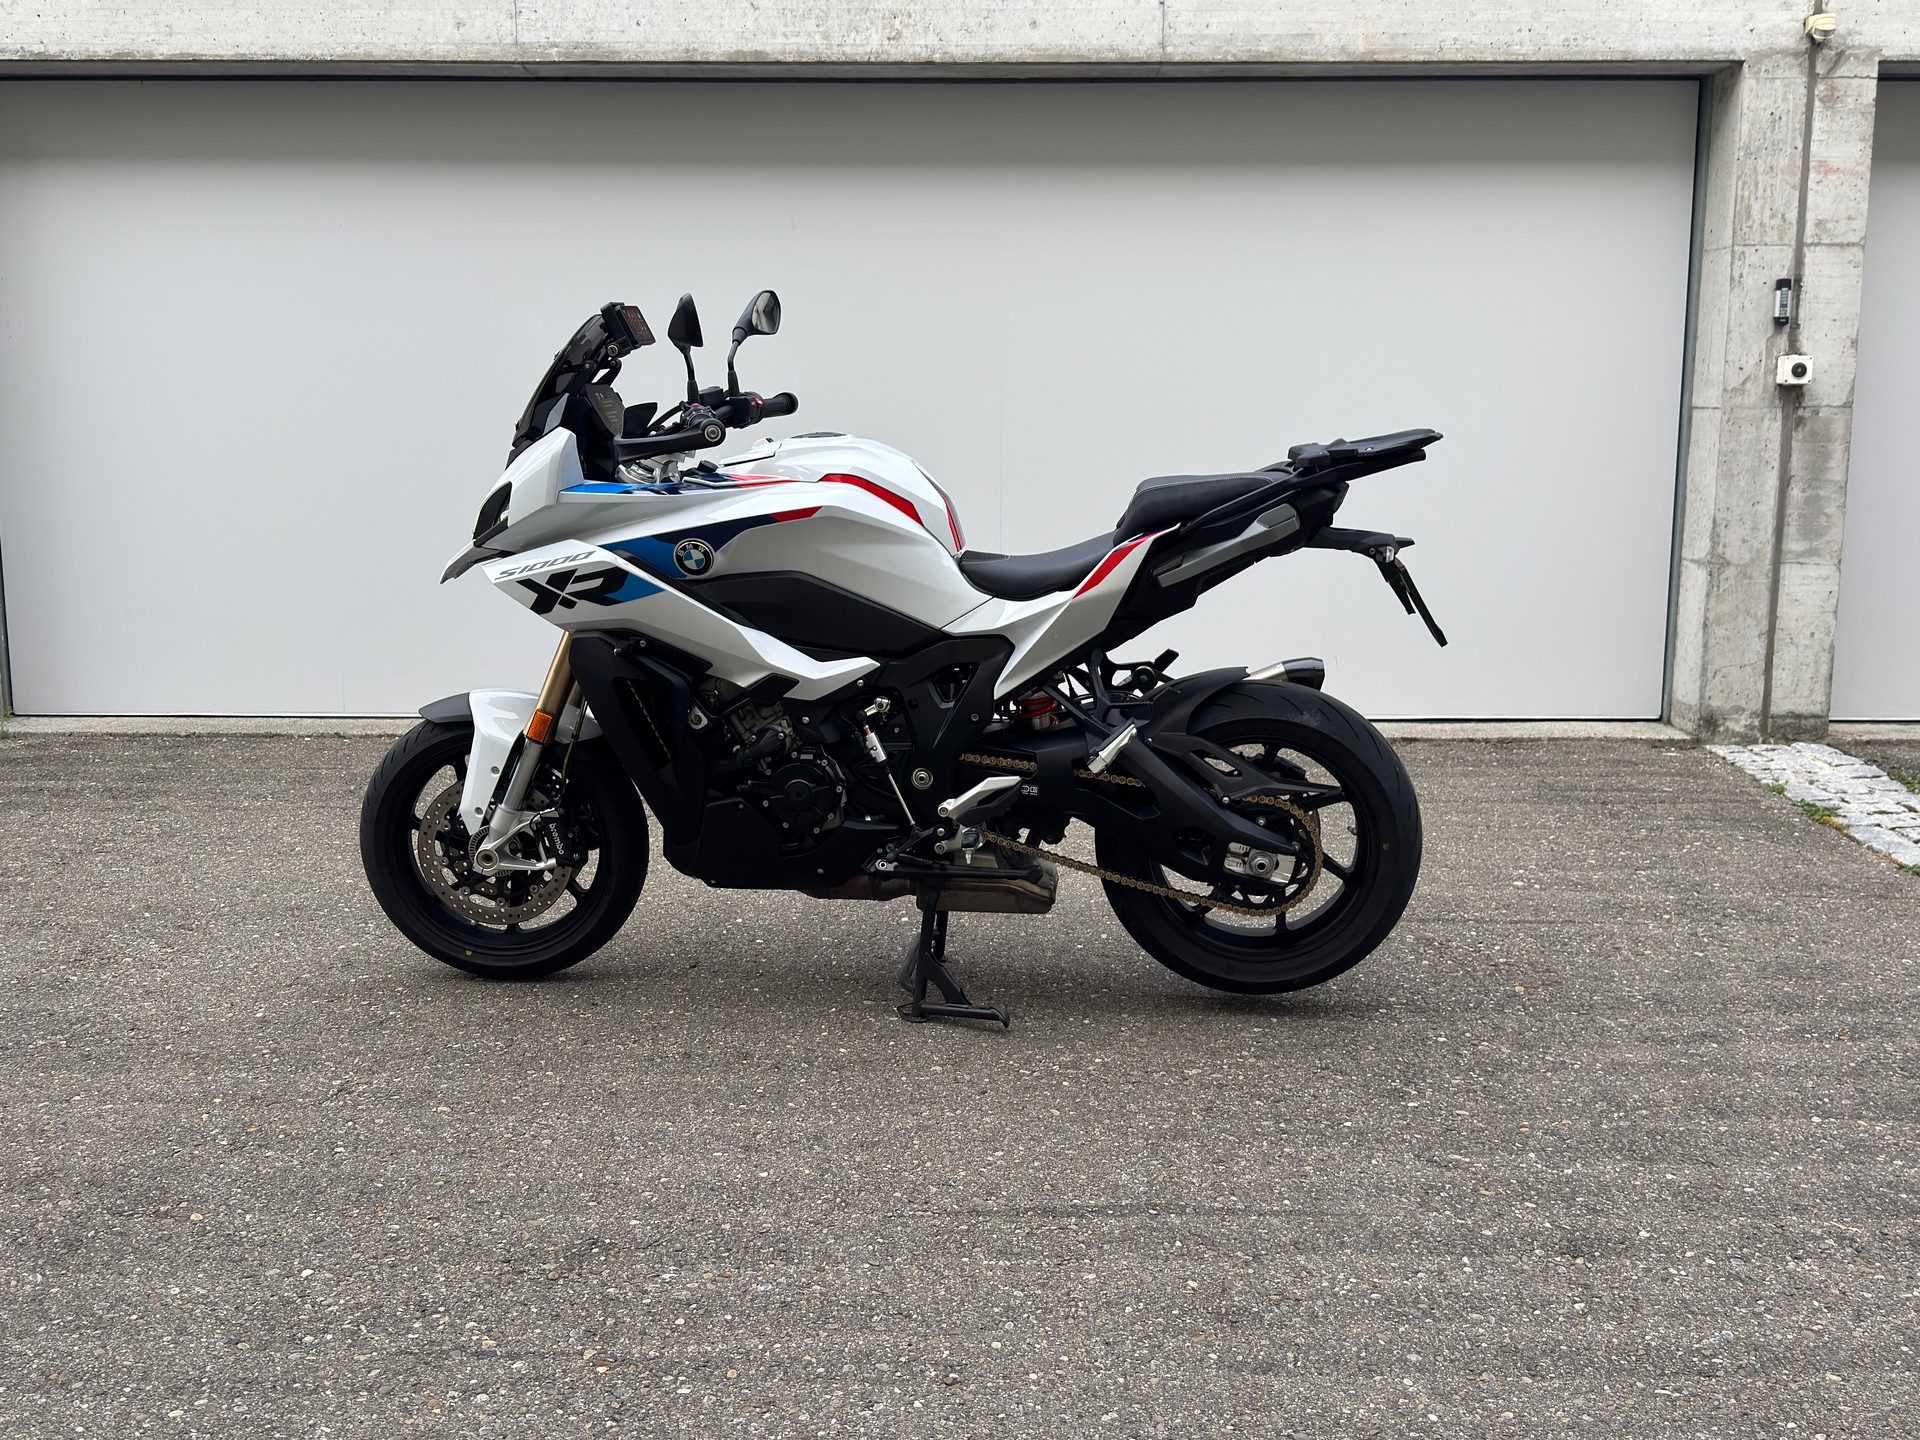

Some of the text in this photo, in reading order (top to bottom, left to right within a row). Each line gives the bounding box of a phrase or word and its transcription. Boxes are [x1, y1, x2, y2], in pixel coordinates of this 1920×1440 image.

[494, 550, 597, 581] S1000
[677, 543, 706, 557] BMW
[515, 566, 630, 615] XR
[549, 822, 565, 855] brembo
